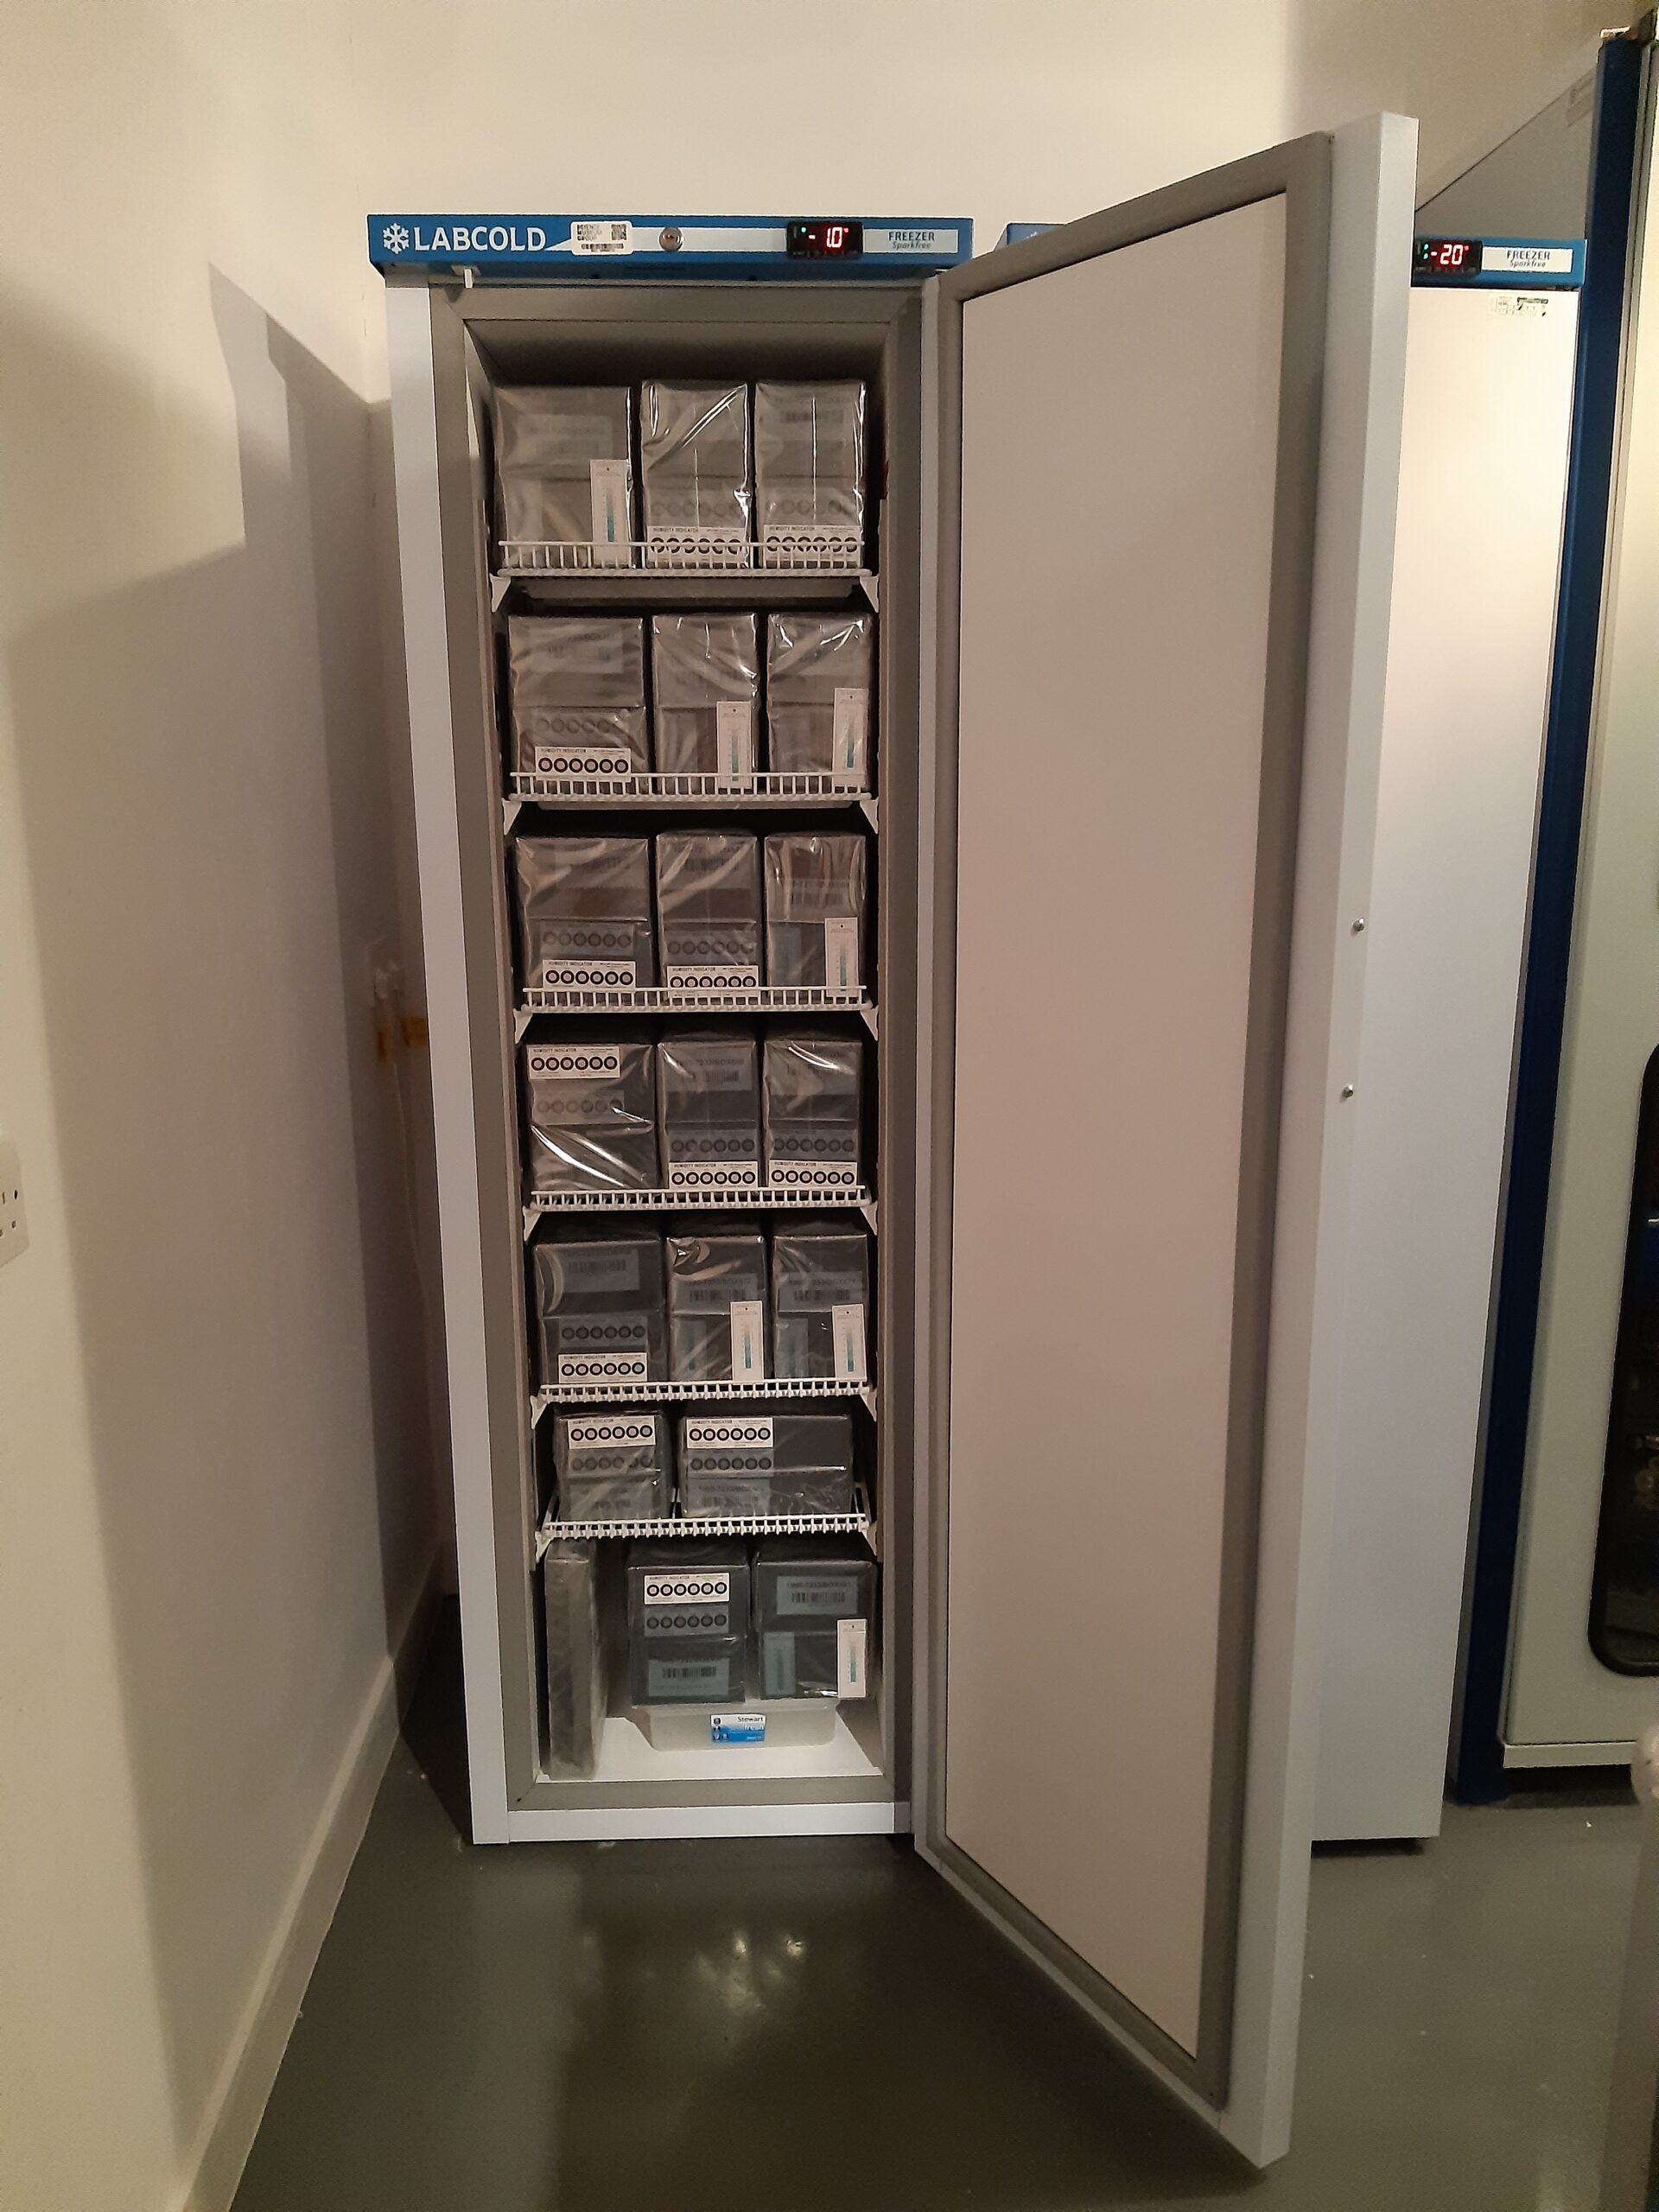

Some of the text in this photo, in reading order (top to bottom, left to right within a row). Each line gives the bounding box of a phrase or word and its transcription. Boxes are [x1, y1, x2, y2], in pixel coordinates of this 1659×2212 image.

[415, 226, 546, 251] LABCOLD
[888, 232, 935, 241] FREEZER
[893, 241, 931, 251] Sparkfree
[1507, 250, 1551, 259] FREEZER
